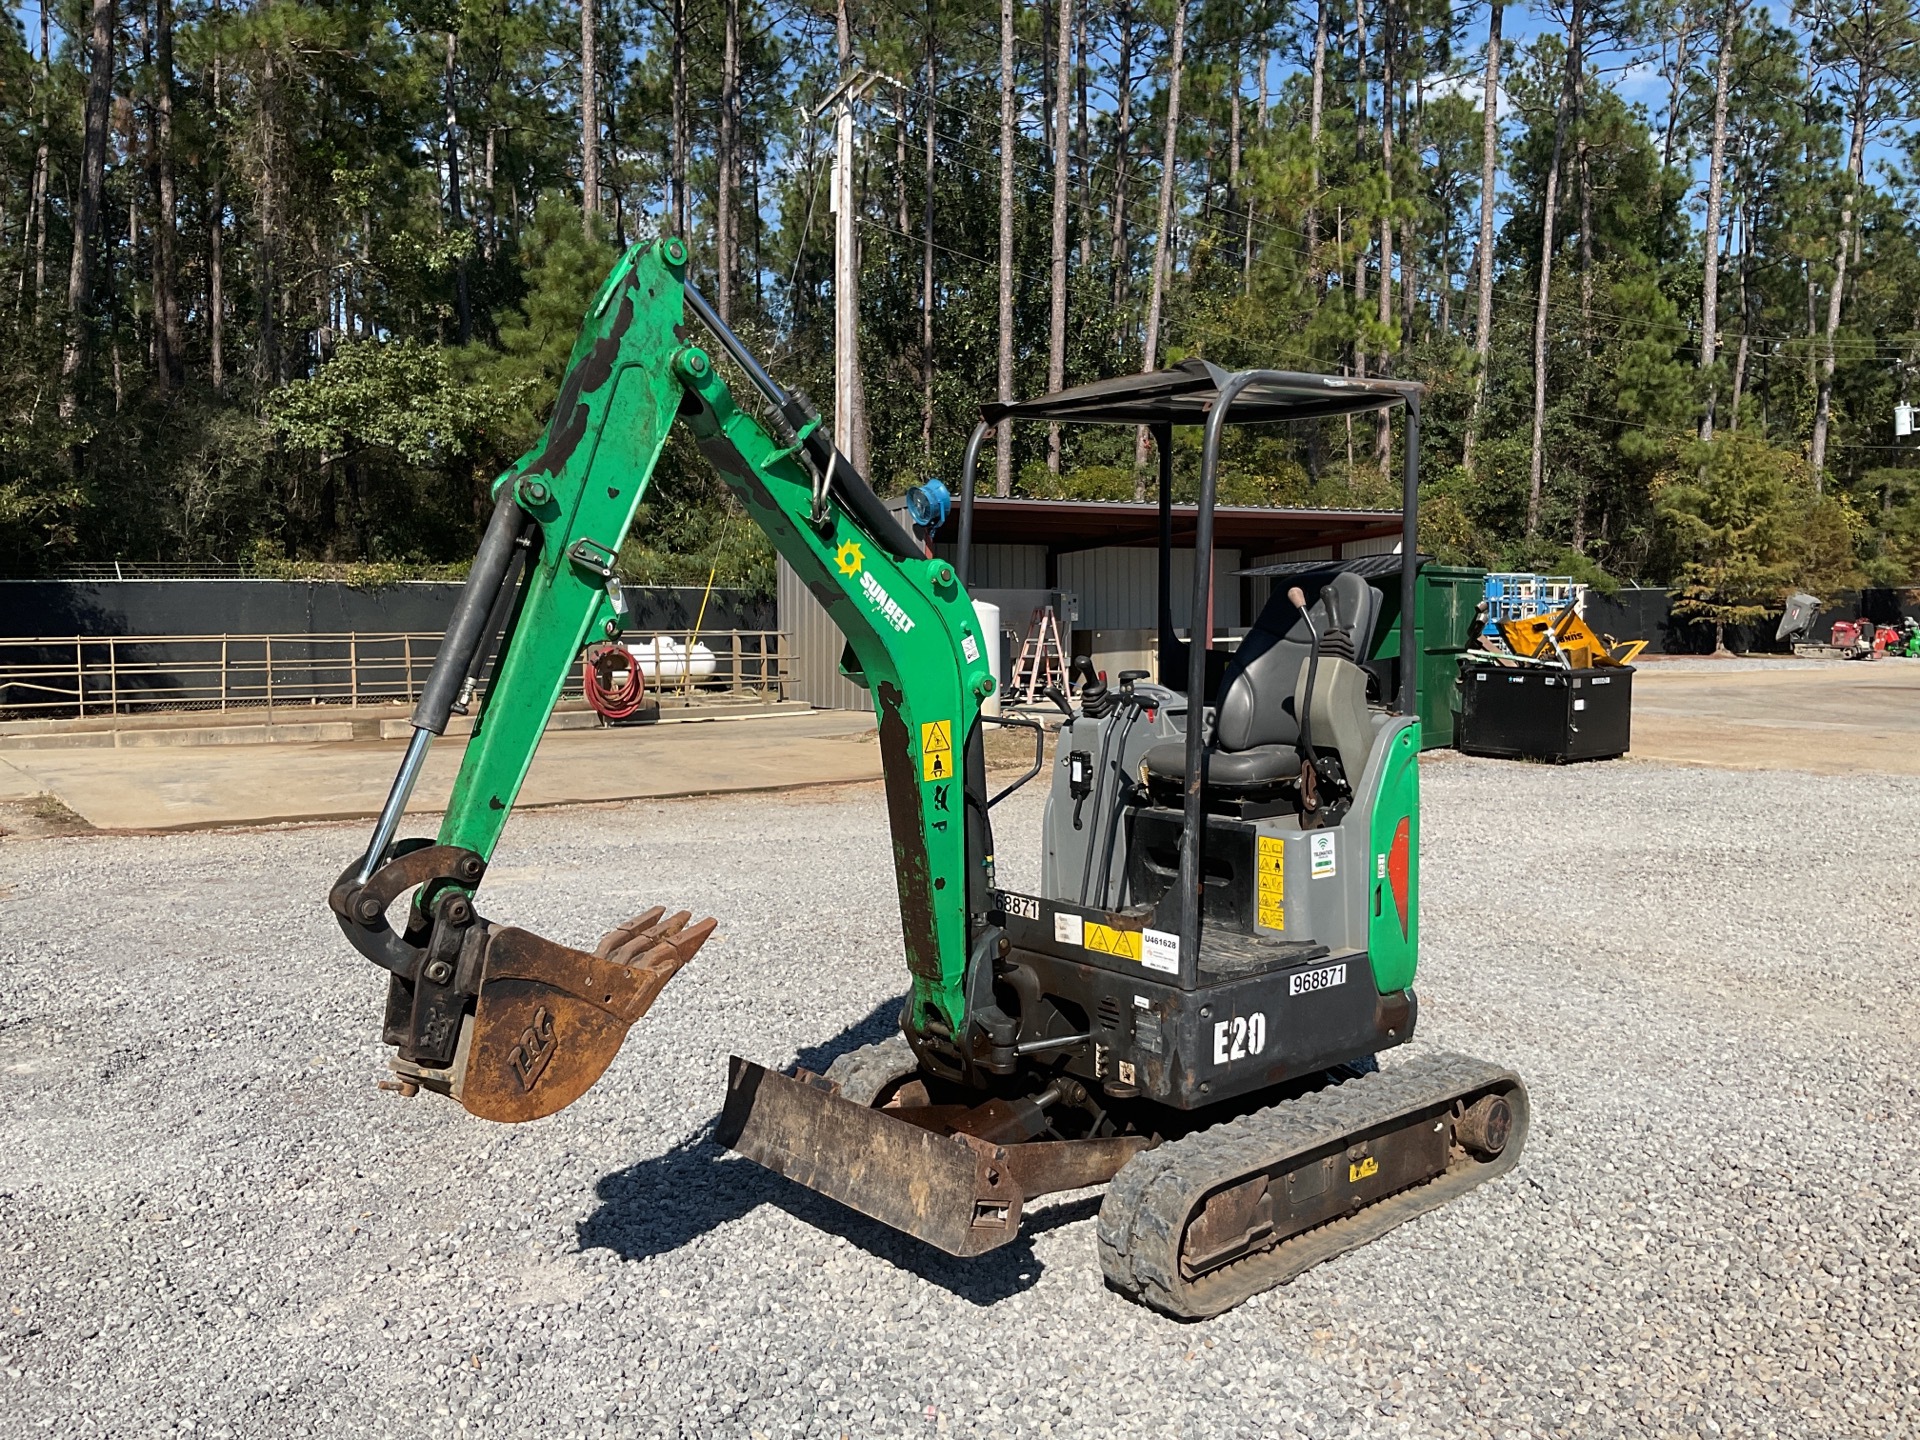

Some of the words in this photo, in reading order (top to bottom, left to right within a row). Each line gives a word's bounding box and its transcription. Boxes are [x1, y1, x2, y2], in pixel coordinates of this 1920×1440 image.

[859, 570, 916, 634] SUNBELT
[992, 893, 1037, 918] 68871
[1144, 934, 1177, 949] U461628
[1293, 965, 1344, 993] 968871
[1213, 1012, 1266, 1065] E20
